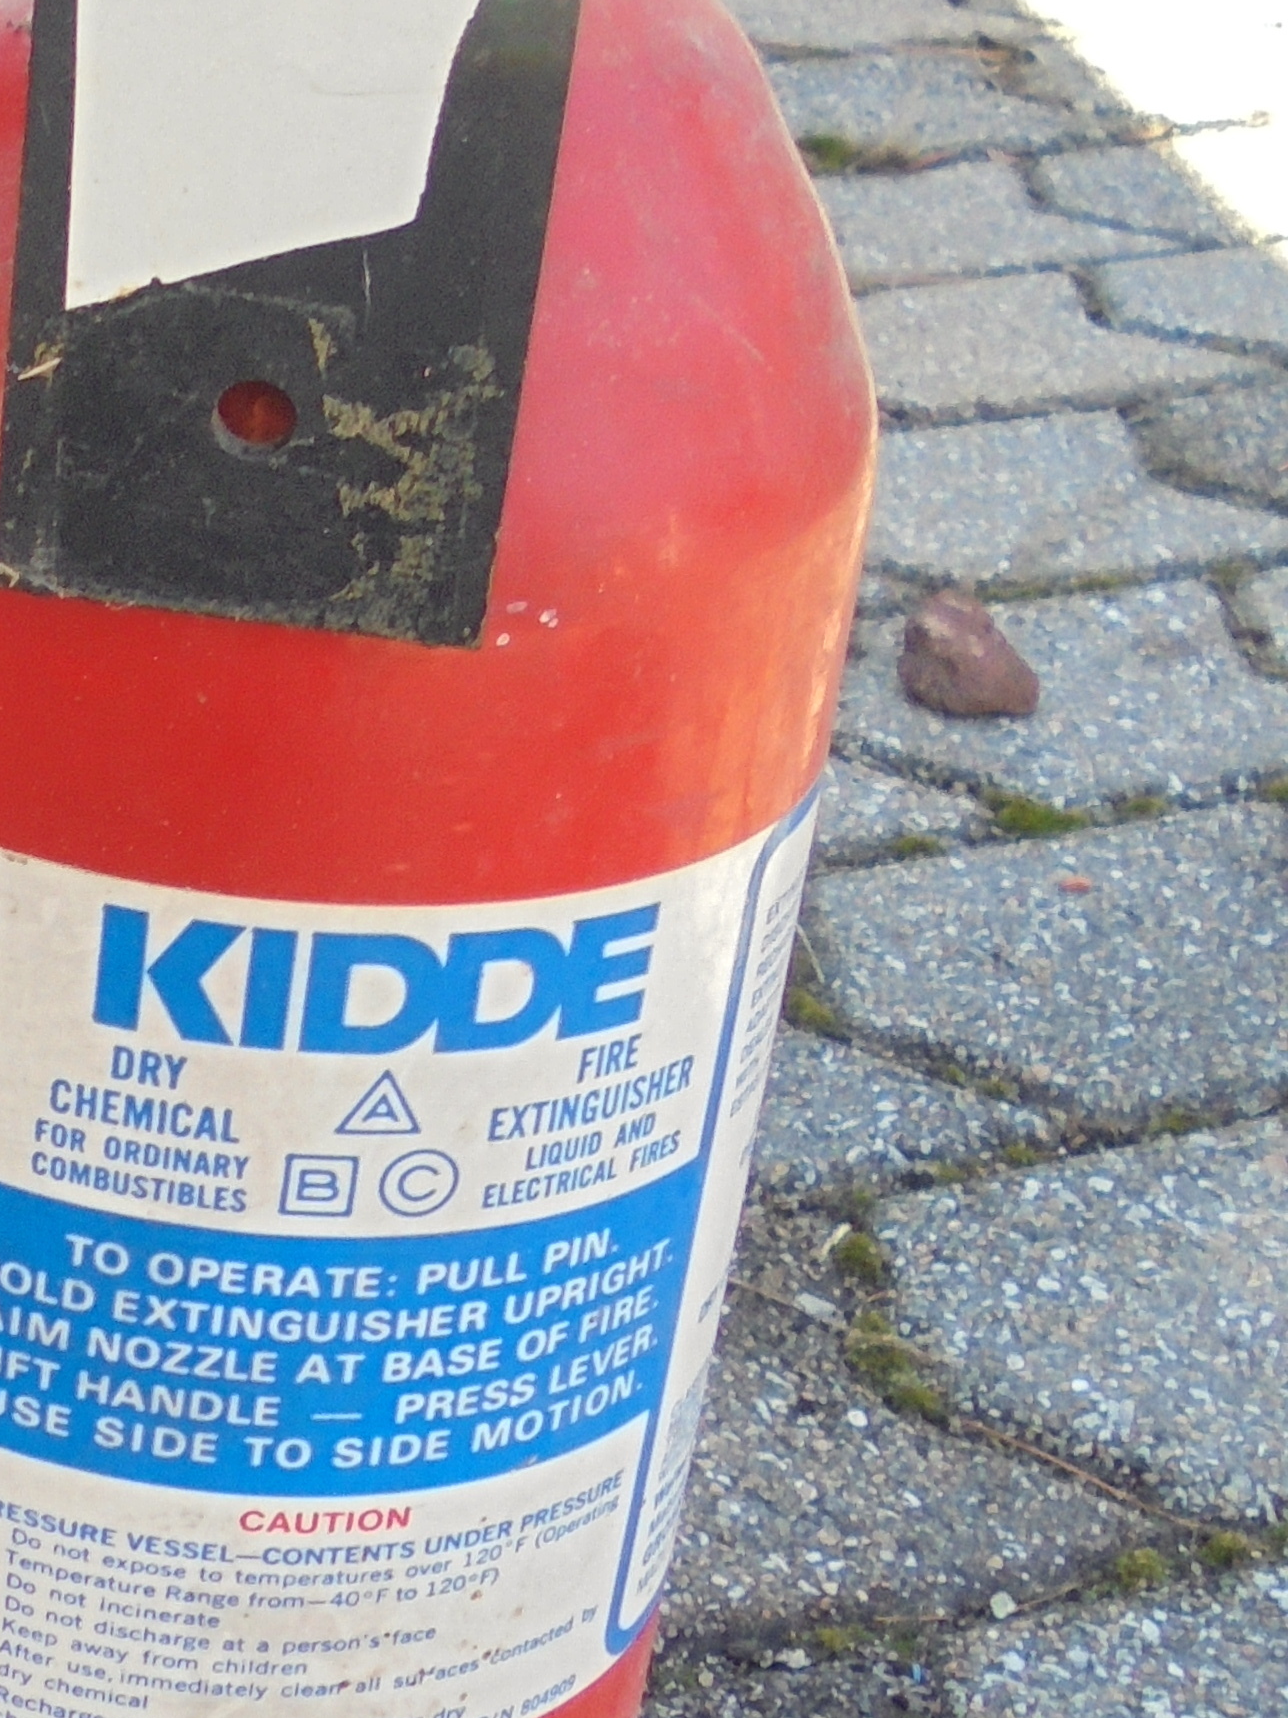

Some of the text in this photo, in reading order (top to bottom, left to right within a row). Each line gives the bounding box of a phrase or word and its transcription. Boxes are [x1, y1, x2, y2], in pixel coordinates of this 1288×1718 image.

[93, 902, 661, 1055] KIDDE
[110, 1045, 188, 1086] DRY
[576, 1034, 643, 1084] FIRE
[49, 1079, 240, 1145] CHEMICAL
[361, 1095, 398, 1122] A
[486, 1055, 694, 1143] EXTINGUISHER
[35, 1119, 250, 1181] FOR ORDINARY
[481, 1130, 682, 1211] ELECTRICAL FIRES
[525, 1111, 657, 1172] LIQUID AND
[30, 1152, 249, 1214] COMBUSTIBLES
[297, 1172, 340, 1201] B
[398, 1172, 441, 1201] C
[65, 1227, 620, 1301] TO OPERATE: PULL PIN.
[111, 1289, 488, 1344] EXTINGUISHER
[503, 1238, 674, 1326] UPRIGHT.
[86, 1330, 278, 1384] NOZZLE
[294, 1353, 367, 1386] AT
[381, 1339, 502, 1385] BASE
[516, 1319, 568, 1363] OF
[576, 1286, 660, 1343] FIRE.
[76, 1372, 281, 1427] HANDLE
[394, 1374, 538, 1425] PRESS
[549, 1324, 660, 1393] LEVER.
[93, 1419, 219, 1464] SIDE
[246, 1434, 312, 1470] TO
[330, 1428, 450, 1468] SIDE
[469, 1371, 644, 1453] MOTION.
[11, 1494, 620, 1591] Do not expose to temperatures over 120°F (Operating
[238, 1506, 411, 1535] CAUTION
[424, 1520, 512, 1556] UNDER
[520, 1468, 625, 1533] PRESSURE
[6, 1549, 156, 1598] Temperature
[165, 1585, 240, 1610] Range
[396, 1586, 418, 1602] to
[426, 1567, 500, 1599] 120°F)
[6, 1572, 221, 1629] Do not incinerate
[1, 1616, 308, 1677] Keep away from children
[4, 1595, 437, 1657] Do not discharge at a person's face
[67, 1661, 113, 1683] use,
[120, 1671, 268, 1700] immediately
[280, 1679, 341, 1699] clean
[355, 1677, 381, 1694] all
[393, 1658, 480, 1689] surfaces
[490, 1615, 574, 1666] contacted
[582, 1604, 598, 1627] by
[44, 1677, 149, 1710] chemical
[520, 1673, 576, 1717] 804909
